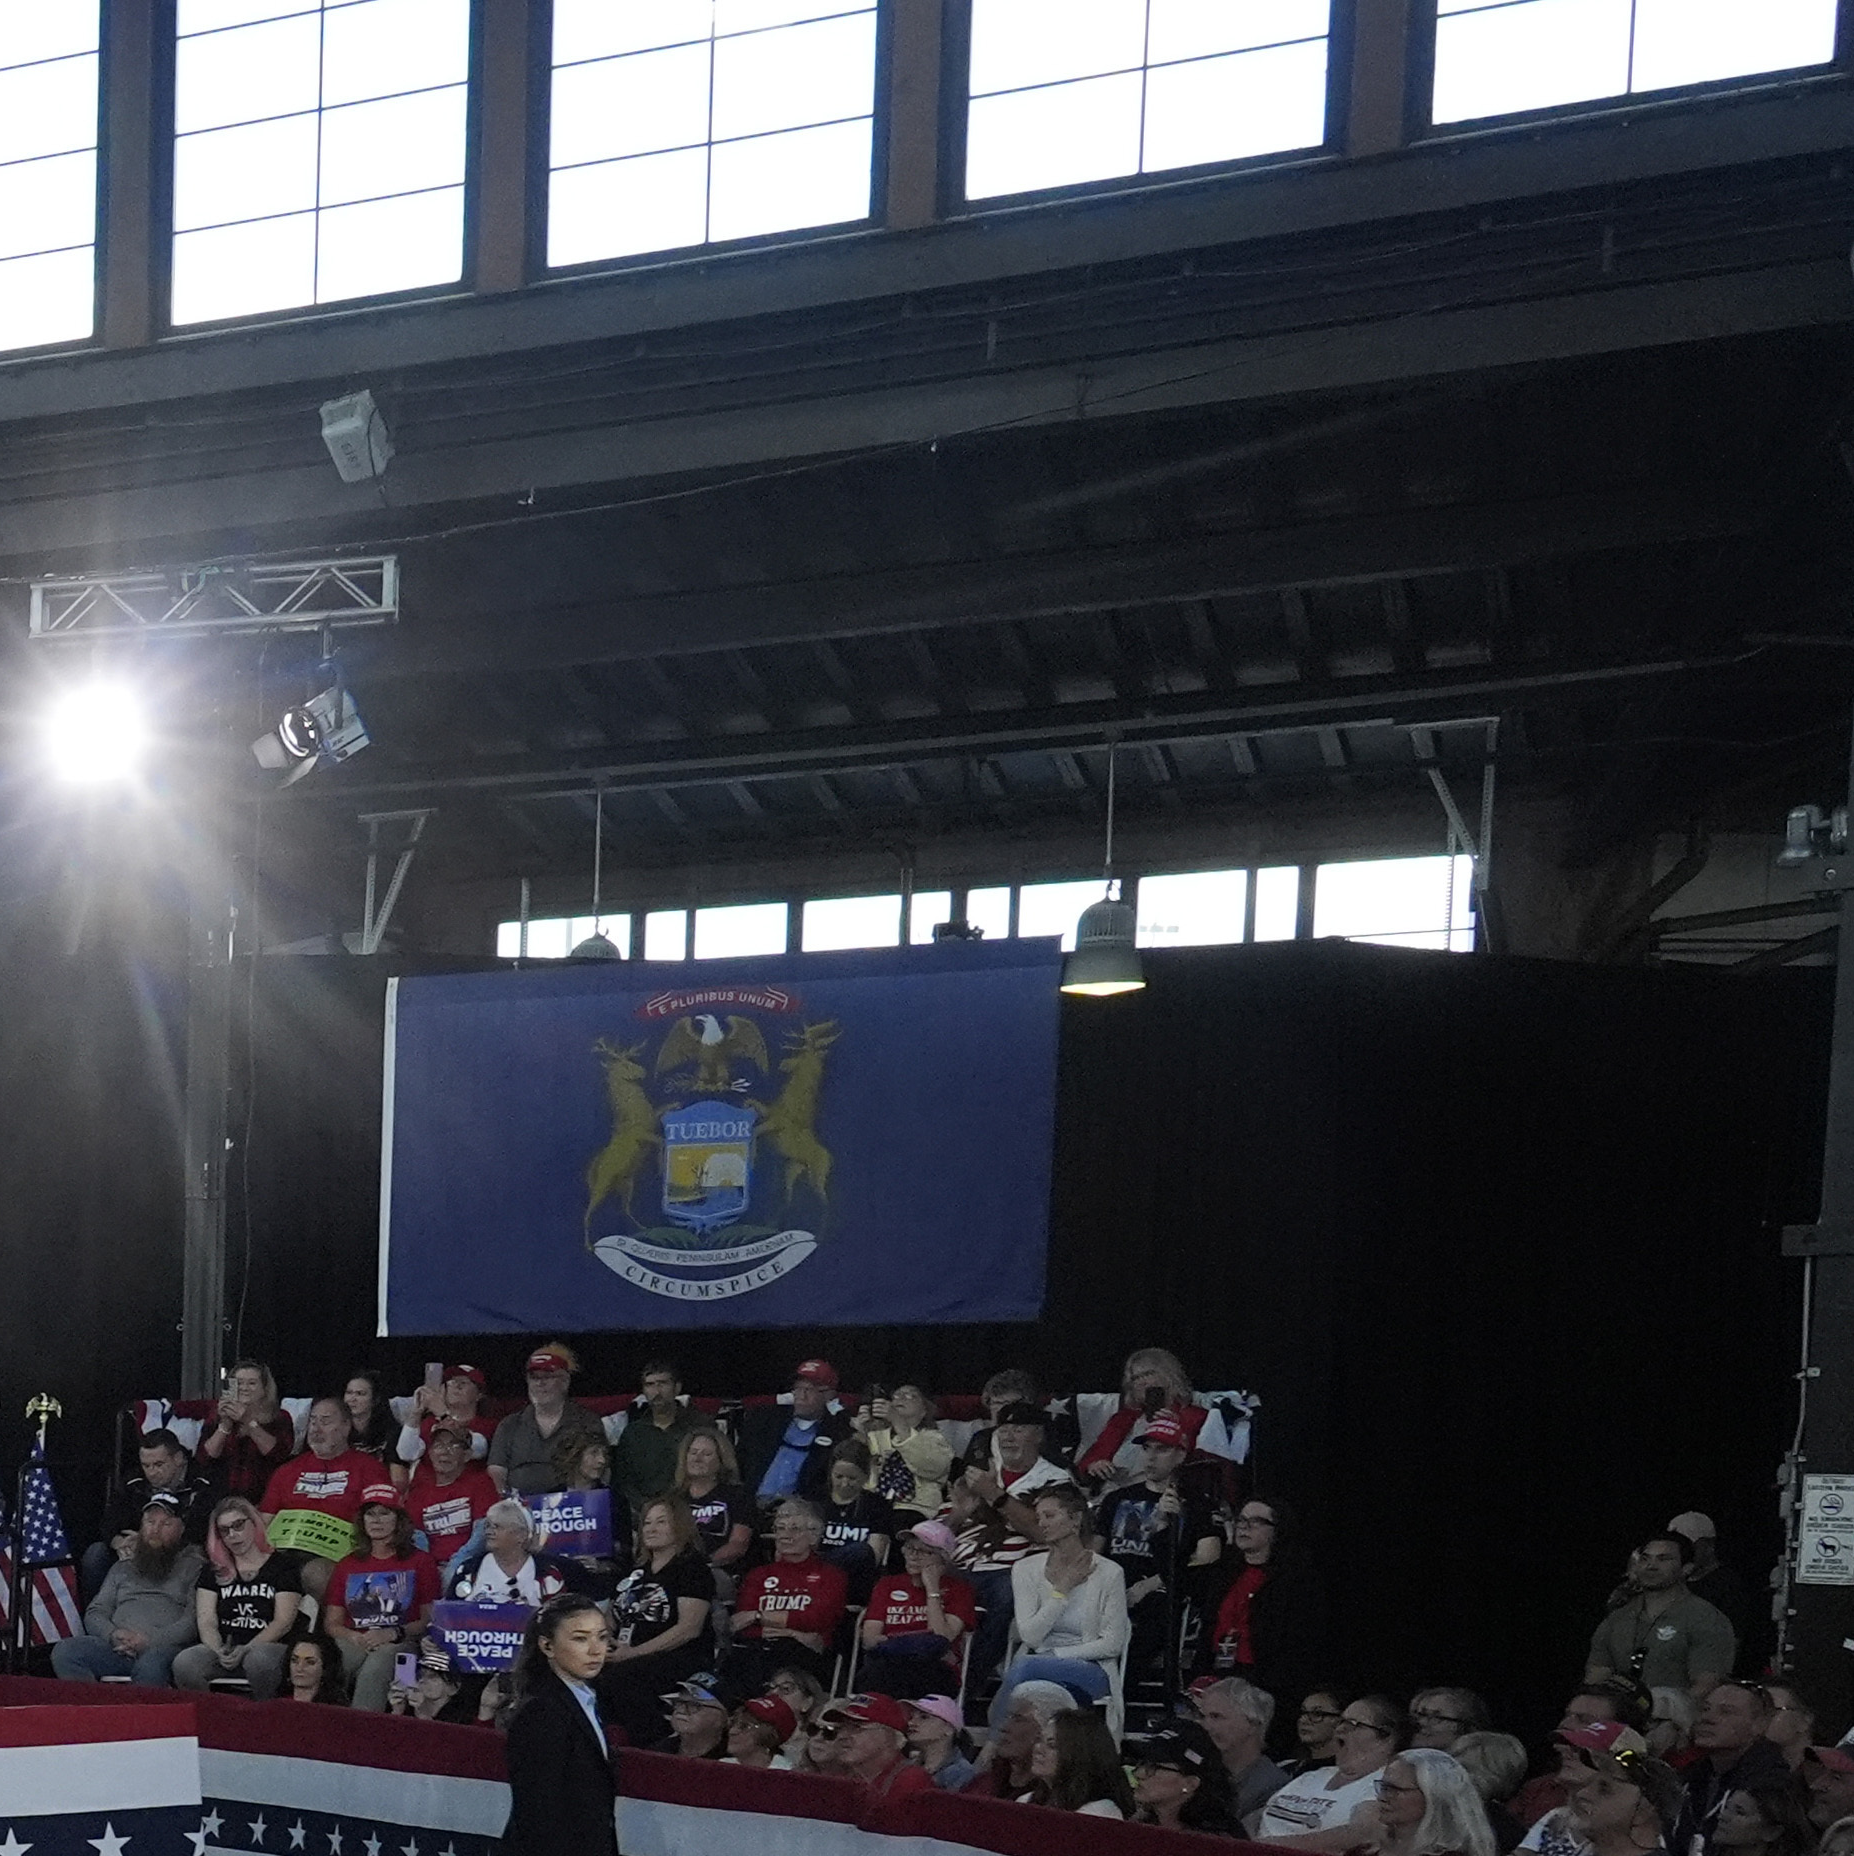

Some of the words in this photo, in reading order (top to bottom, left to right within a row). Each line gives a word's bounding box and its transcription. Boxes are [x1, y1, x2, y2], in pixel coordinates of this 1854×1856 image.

[670, 991, 734, 1010] PLURIBUS
[738, 992, 776, 1009] UNUM
[666, 1121, 752, 1141] TUEBOR
[625, 1261, 784, 1298] CIRCUMSPICE
[532, 1506, 583, 1520] PEACE
[536, 1518, 597, 1535] ROUGH
[826, 1525, 870, 1543] UMP
[220, 1583, 275, 1599] WARREN
[759, 1594, 811, 1612] TRUMP
[457, 1643, 513, 1659] PEACE
